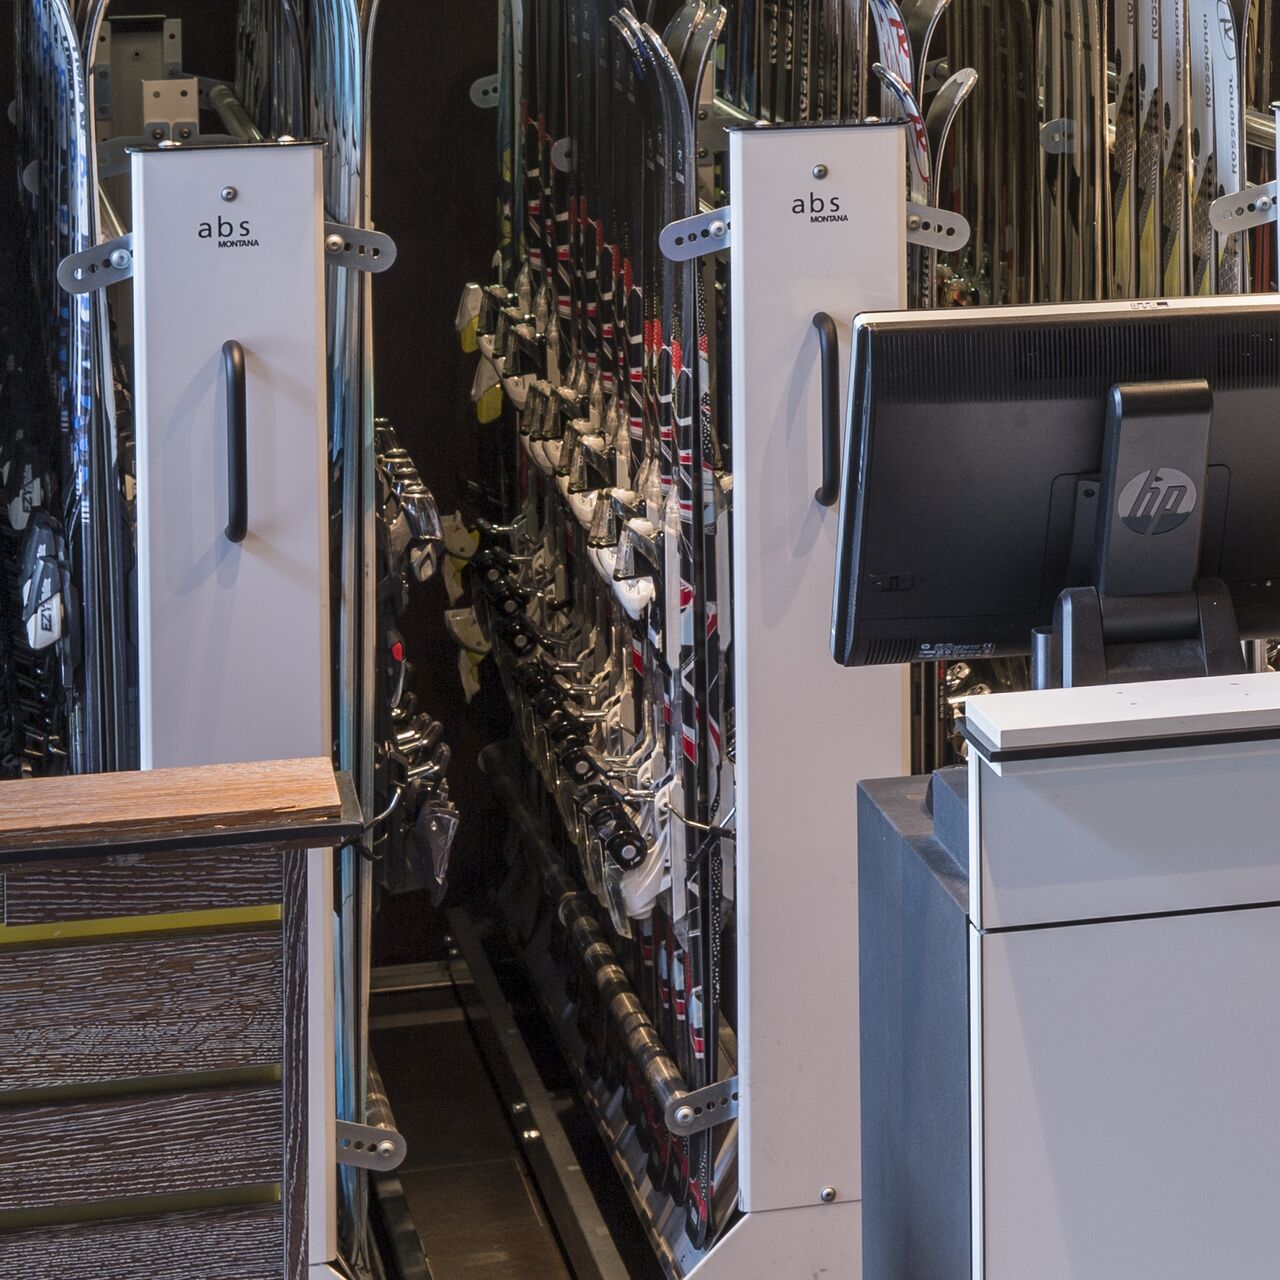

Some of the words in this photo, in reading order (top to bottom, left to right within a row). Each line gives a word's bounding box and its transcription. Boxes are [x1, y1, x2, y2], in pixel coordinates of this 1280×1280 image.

[792, 193, 840, 214] abs
[198, 216, 250, 238] abs
[810, 215, 849, 223] MONTANA
[1120, 467, 1195, 535] hp
